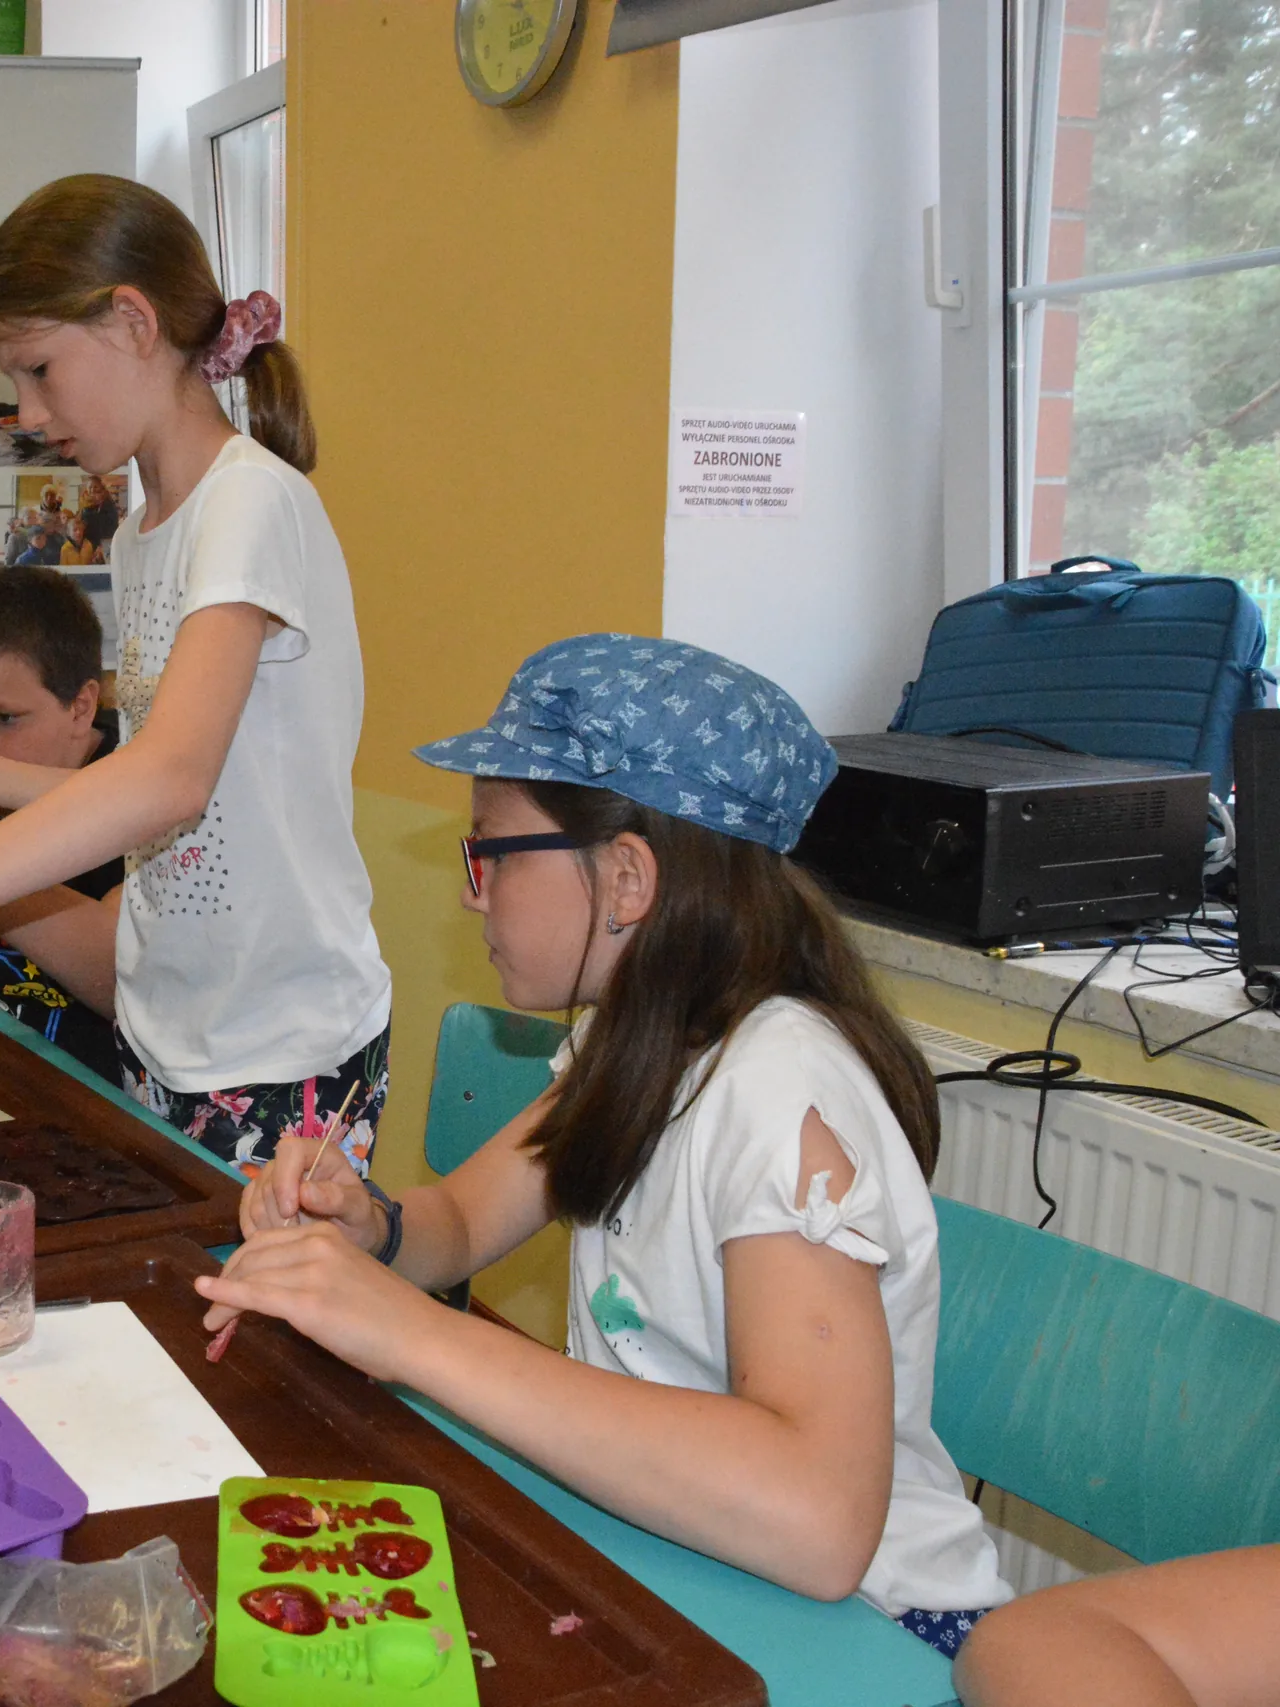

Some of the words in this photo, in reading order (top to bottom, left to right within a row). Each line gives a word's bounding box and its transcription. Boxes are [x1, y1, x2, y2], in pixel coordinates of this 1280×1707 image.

[707, 420, 753, 430] AUDIO-VIDEO
[754, 421, 797, 432] URUCHAMIA
[681, 432, 725, 444] WYŁĄCZNIE
[727, 435, 761, 445] PERSONEL
[693, 450, 782, 467] ZABRONIONE
[702, 473, 717, 482] JEST
[718, 473, 772, 483] URUCHAMIANIE
[708, 486, 751, 495] AUDIO-VIDEO
[752, 486, 771, 495] PRZEZ
[745, 498, 754, 507] W
